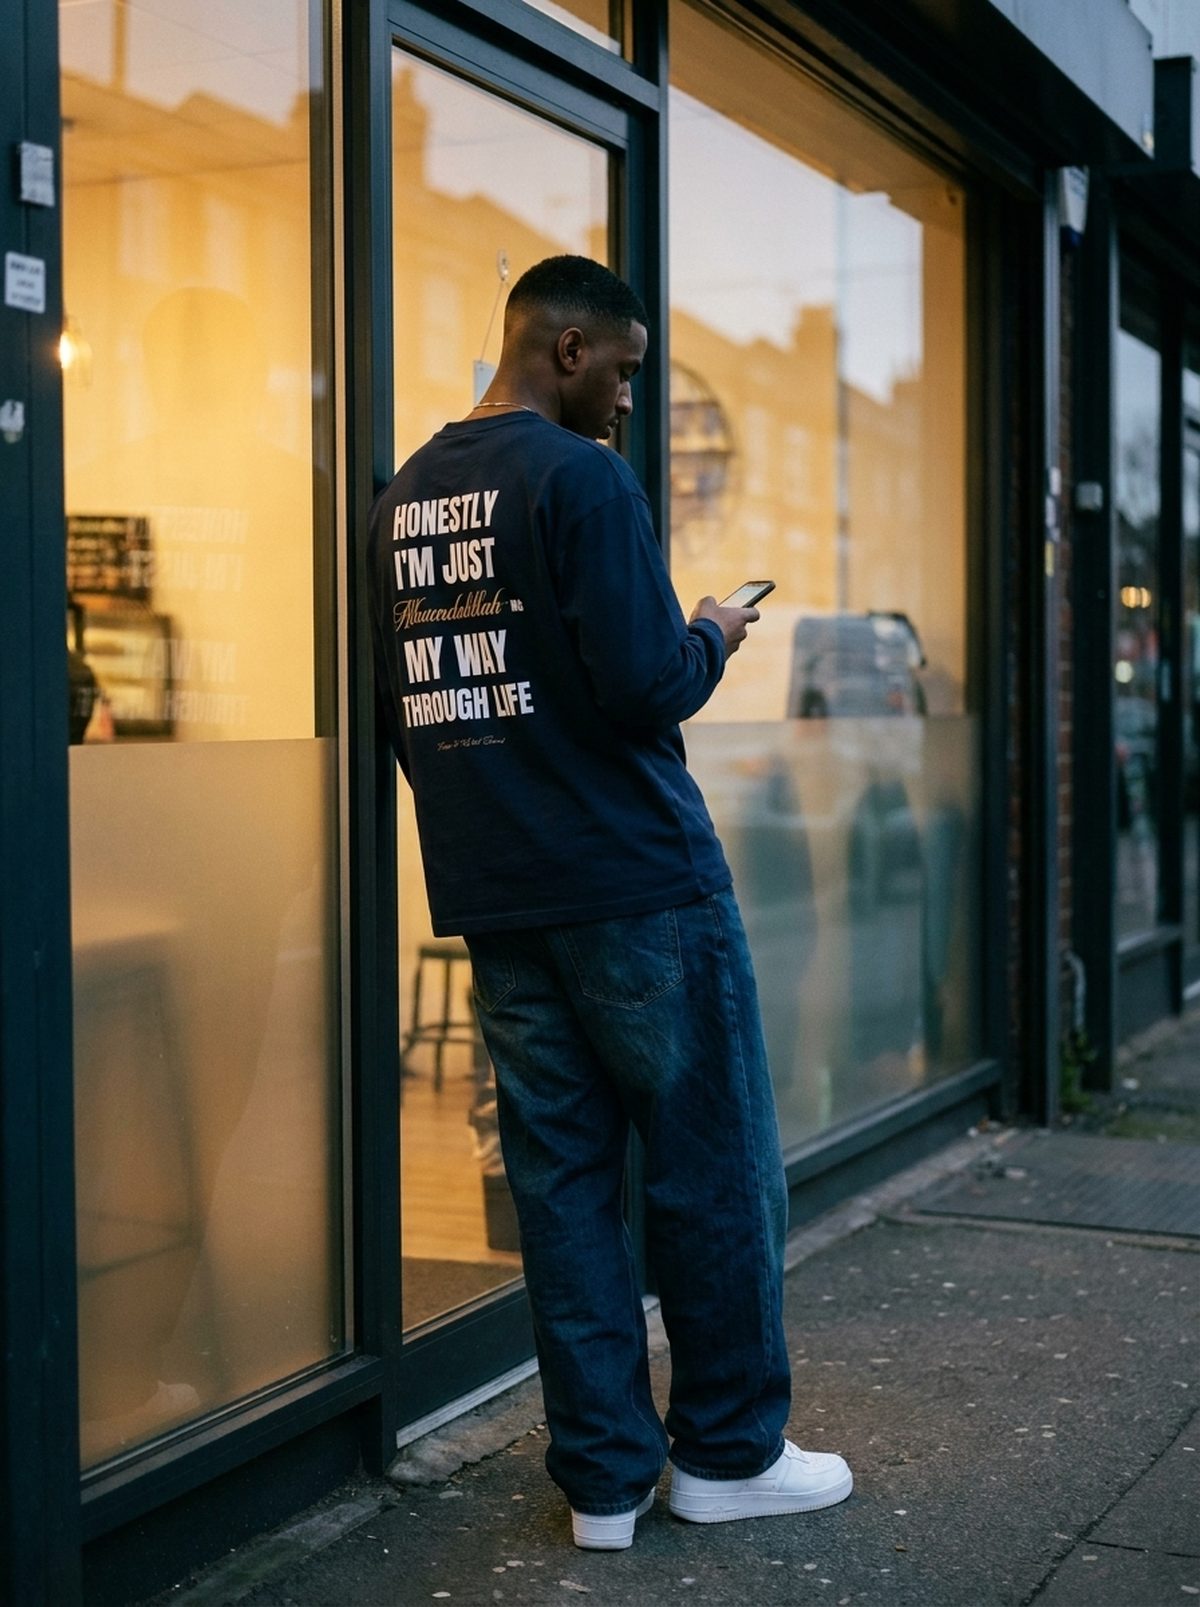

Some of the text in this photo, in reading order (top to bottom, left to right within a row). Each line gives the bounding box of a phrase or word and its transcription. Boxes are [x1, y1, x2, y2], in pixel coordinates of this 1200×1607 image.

[393, 490, 499, 541] HONESTLY
[394, 537, 494, 590] I'M JUST
[404, 629, 507, 683] MY WAY
[402, 681, 535, 728] THROUGH LIFE
